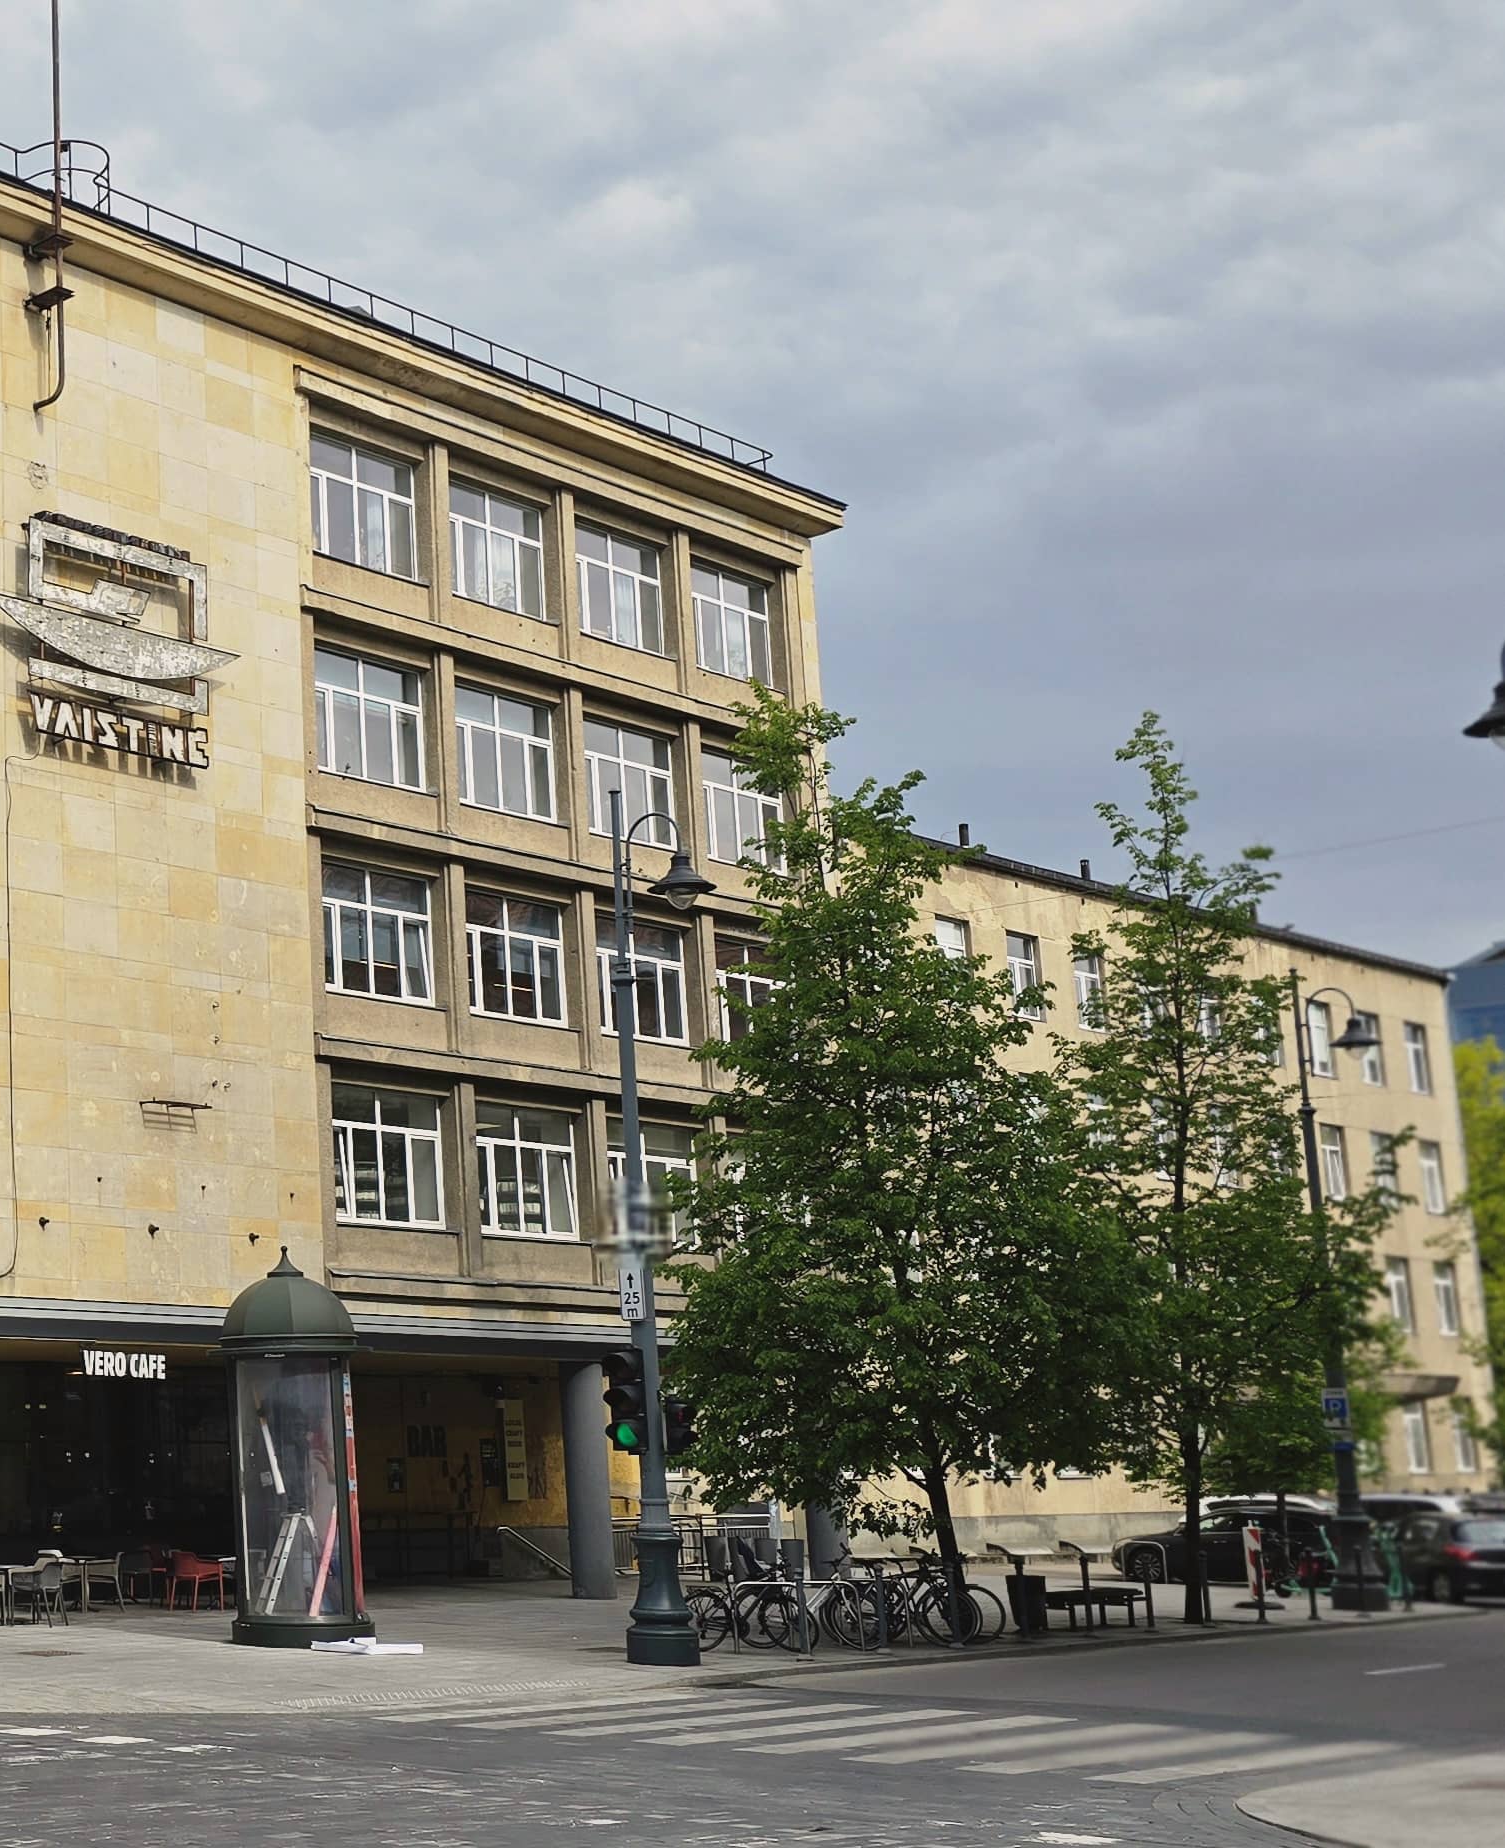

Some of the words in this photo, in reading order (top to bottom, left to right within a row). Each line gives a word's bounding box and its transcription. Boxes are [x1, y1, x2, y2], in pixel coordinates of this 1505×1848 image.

[624, 1291, 640, 1304] 25
[627, 1308, 638, 1317] m
[83, 1349, 127, 1377] VERO
[129, 1353, 166, 1380] CAFE
